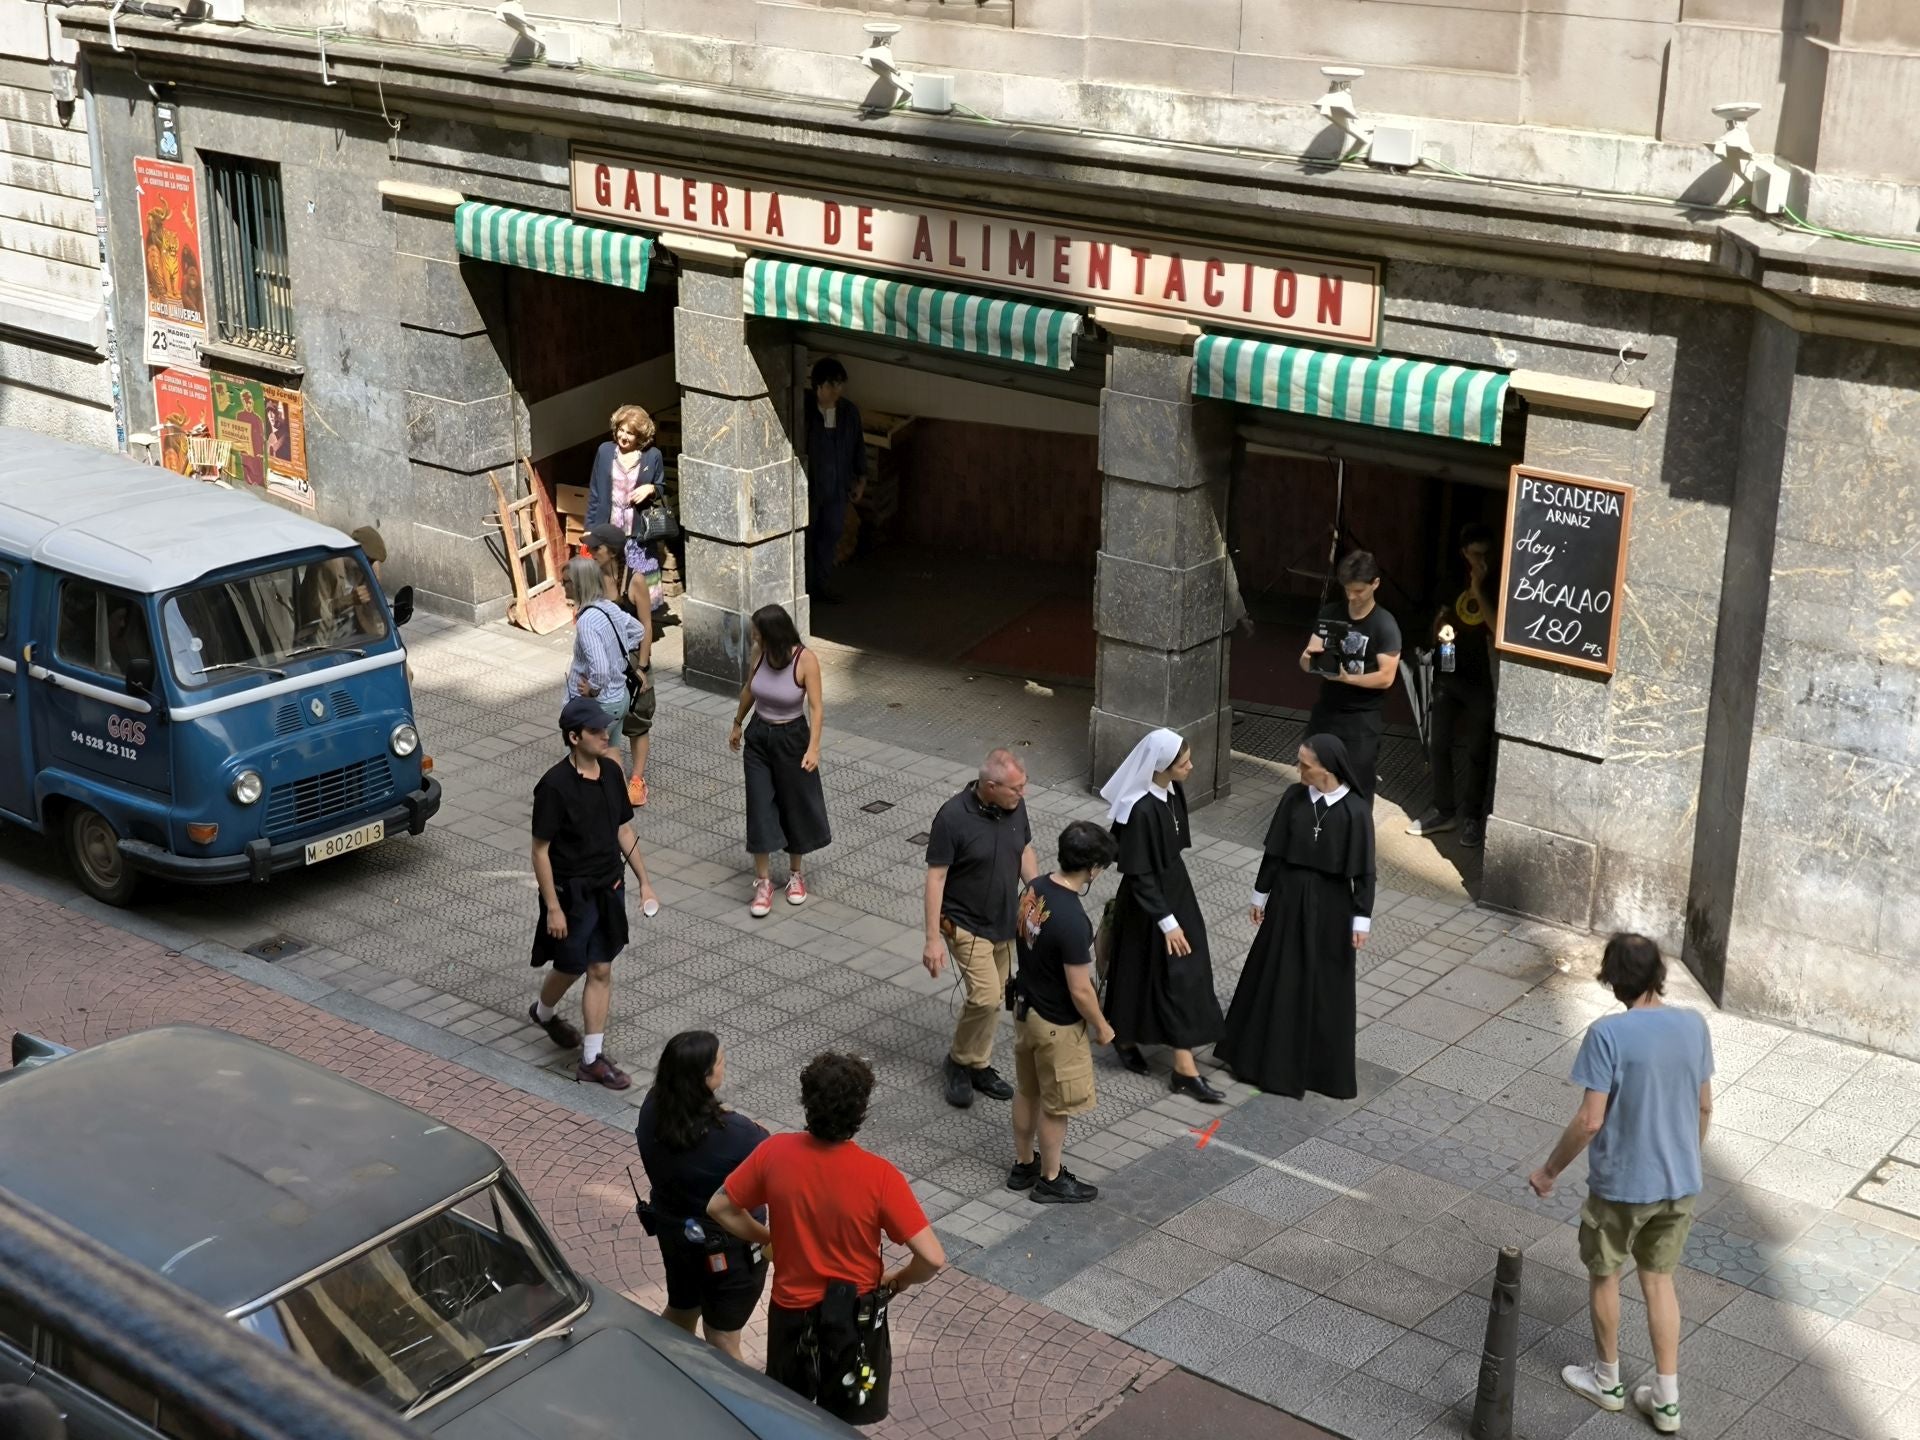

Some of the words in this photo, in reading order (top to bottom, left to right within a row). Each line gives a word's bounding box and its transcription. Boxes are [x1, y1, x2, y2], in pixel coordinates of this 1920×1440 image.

[595, 163, 784, 237] GALERIA
[824, 201, 873, 251] DE
[913, 214, 1343, 326] ALIMENTACION
[150, 301, 169, 317] CIRCO
[168, 303, 204, 324] UNIVERSAL
[152, 330, 168, 351] 23
[167, 328, 190, 339] MADRID
[1513, 576, 1611, 614] BACALAO
[1524, 614, 1582, 645] 180
[107, 713, 147, 745] GAS
[71, 730, 84, 744] 94
[85, 735, 104, 750] 528
[105, 741, 119, 755] 23
[120, 746, 137, 760] 112
